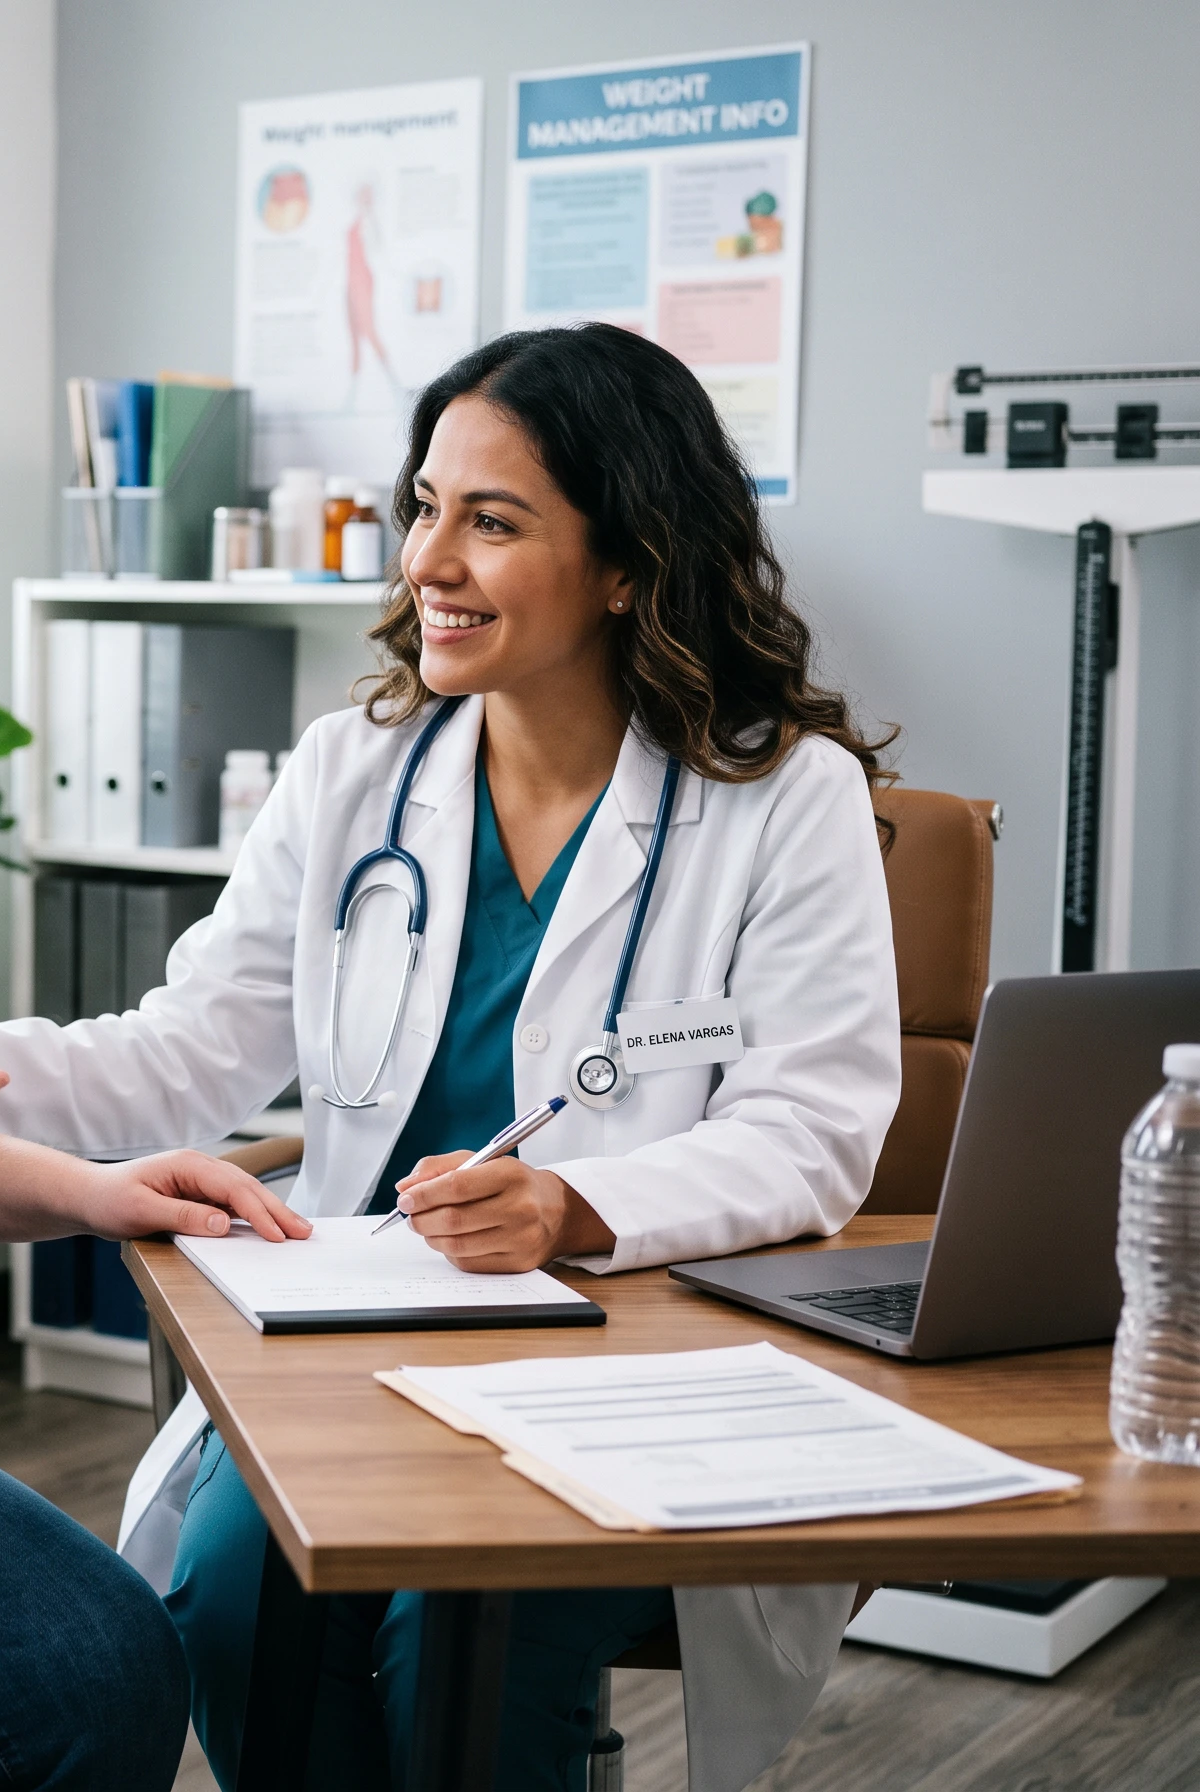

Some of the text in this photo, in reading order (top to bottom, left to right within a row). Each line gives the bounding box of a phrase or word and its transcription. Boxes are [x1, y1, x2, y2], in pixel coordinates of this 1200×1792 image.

[602, 72, 711, 109] WEIGHT
[527, 97, 789, 149] MANAGEMENT INFO
[626, 1025, 734, 1048] DR. ELENA VARGAS
